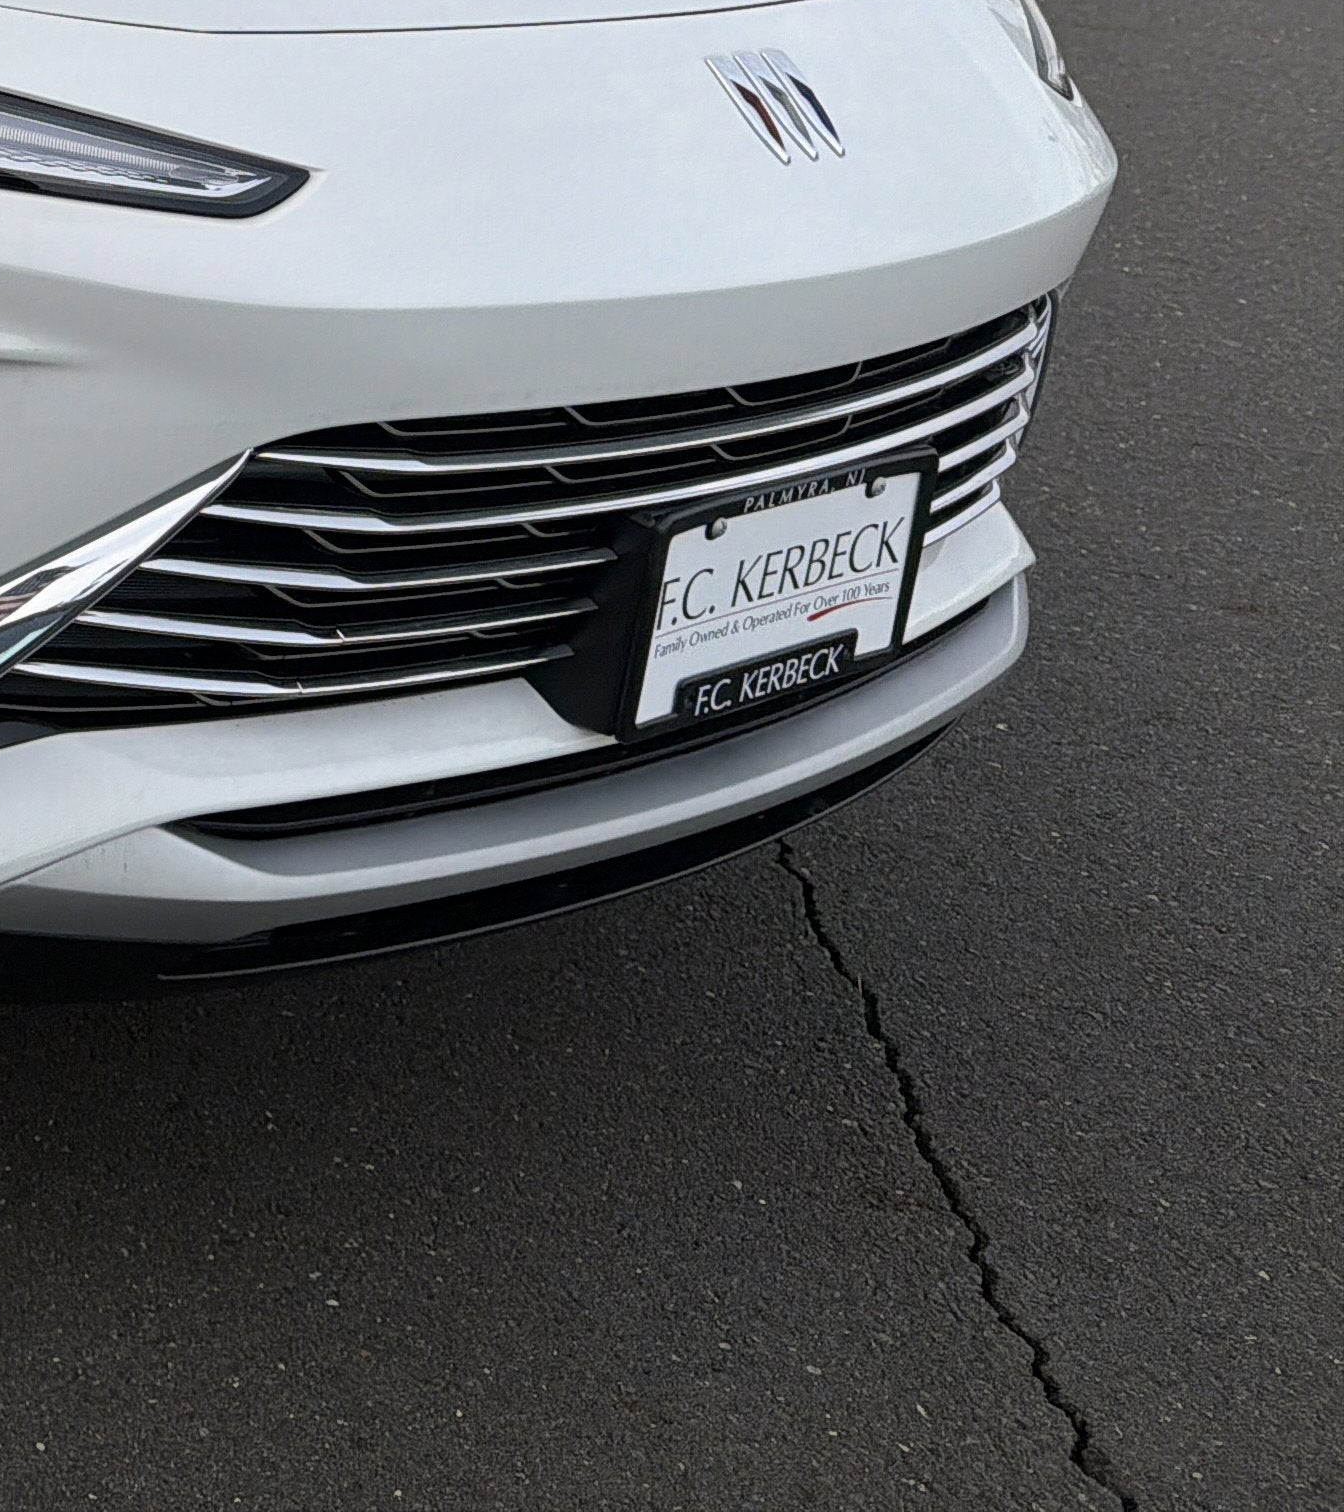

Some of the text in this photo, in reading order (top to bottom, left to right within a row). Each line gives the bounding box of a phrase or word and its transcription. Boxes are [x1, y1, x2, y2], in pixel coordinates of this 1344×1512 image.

[657, 516, 905, 630] F.C. KERBECK
[653, 580, 891, 660] Family Owned & Operated For Over 100 Years
[694, 643, 845, 717] F.C. KERBECK
